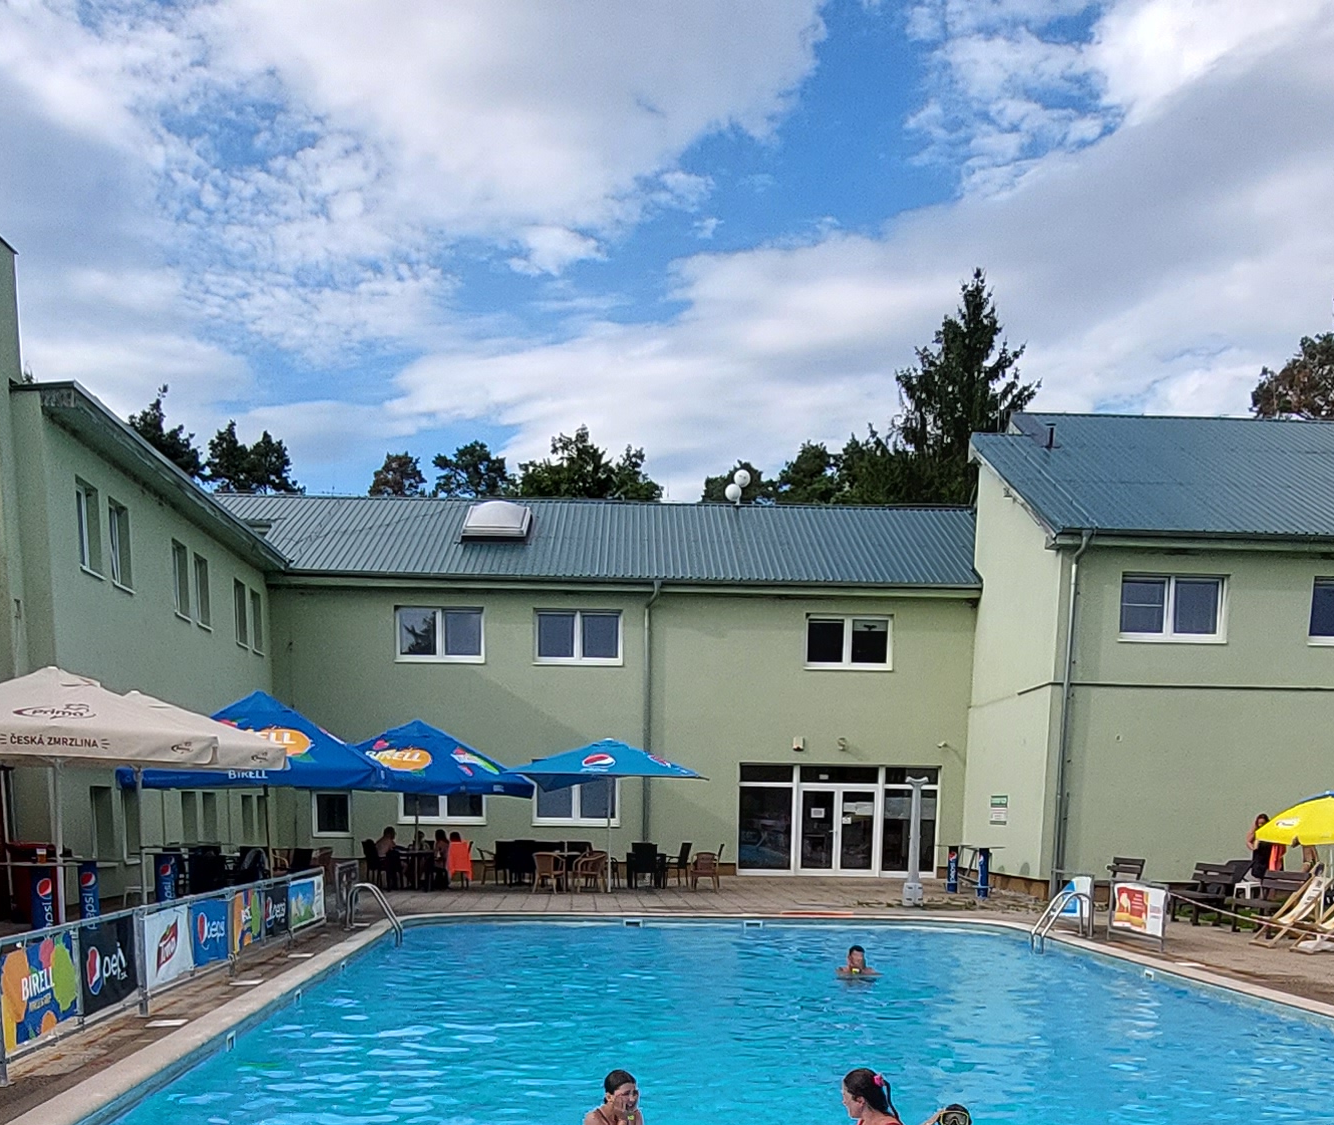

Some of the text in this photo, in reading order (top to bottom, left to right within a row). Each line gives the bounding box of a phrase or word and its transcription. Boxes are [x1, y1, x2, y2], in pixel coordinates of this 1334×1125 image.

[10, 733, 99, 748] ČESKÁ ZMRZLINA
[21, 966, 56, 1002] BIRELL
